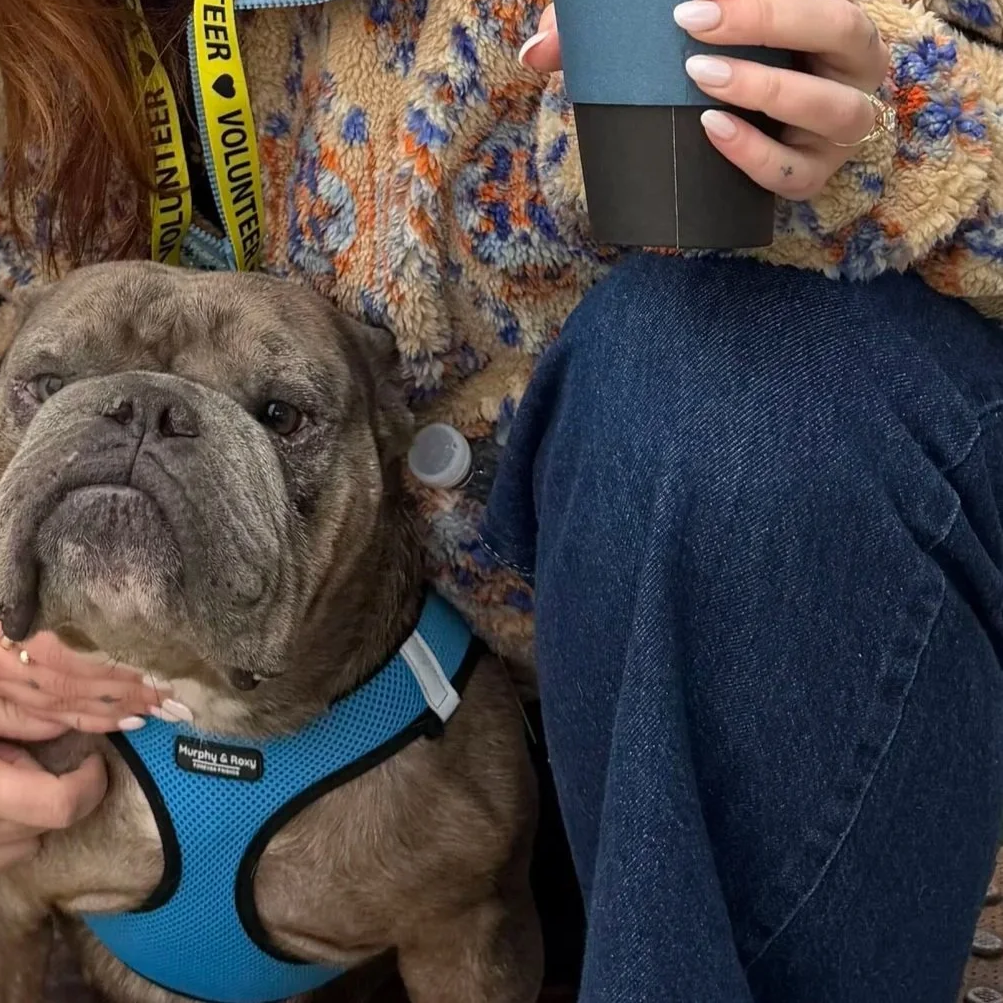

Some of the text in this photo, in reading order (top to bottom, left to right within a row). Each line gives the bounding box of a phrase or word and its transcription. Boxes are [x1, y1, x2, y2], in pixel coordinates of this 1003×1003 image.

[143, 87, 183, 263] VOLUNTEER
[217, 108, 261, 265] VOLUNTEER
[178, 744, 218, 763] Murphy
[219, 753, 228, 763] &
[230, 754, 257, 770] Roxy
